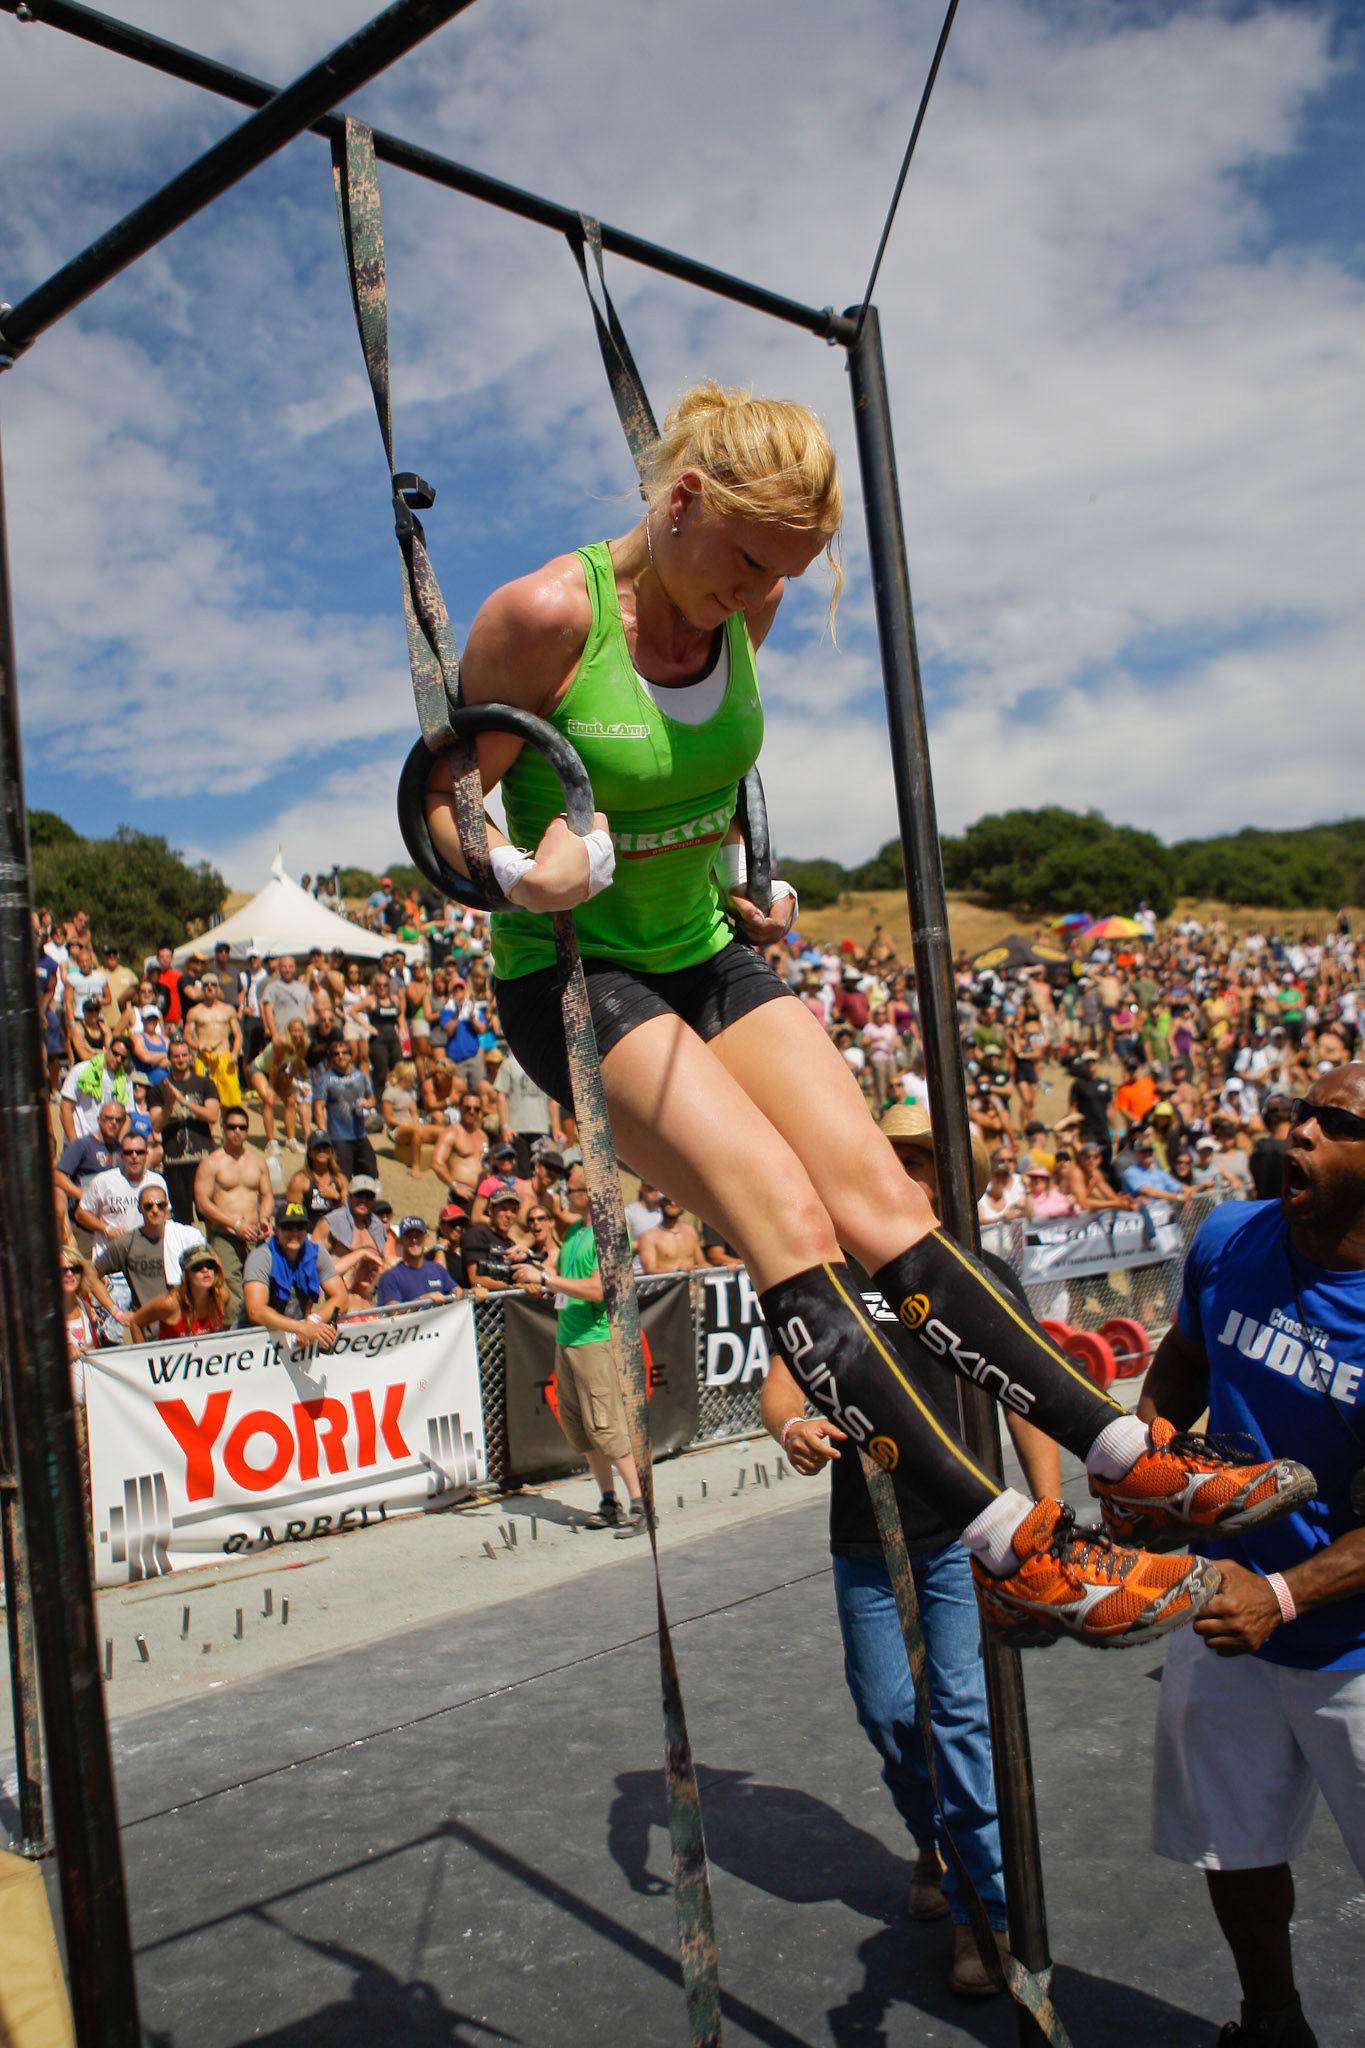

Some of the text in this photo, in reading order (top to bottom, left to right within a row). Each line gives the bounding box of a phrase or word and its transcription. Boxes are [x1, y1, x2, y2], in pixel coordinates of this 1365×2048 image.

[147, 1347, 255, 1385] Where
[262, 1340, 283, 1367] it
[1217, 1309, 1364, 1405] JUDGE
[1268, 1307, 1330, 1350] CrossFit
[153, 1381, 412, 1502] YORK
